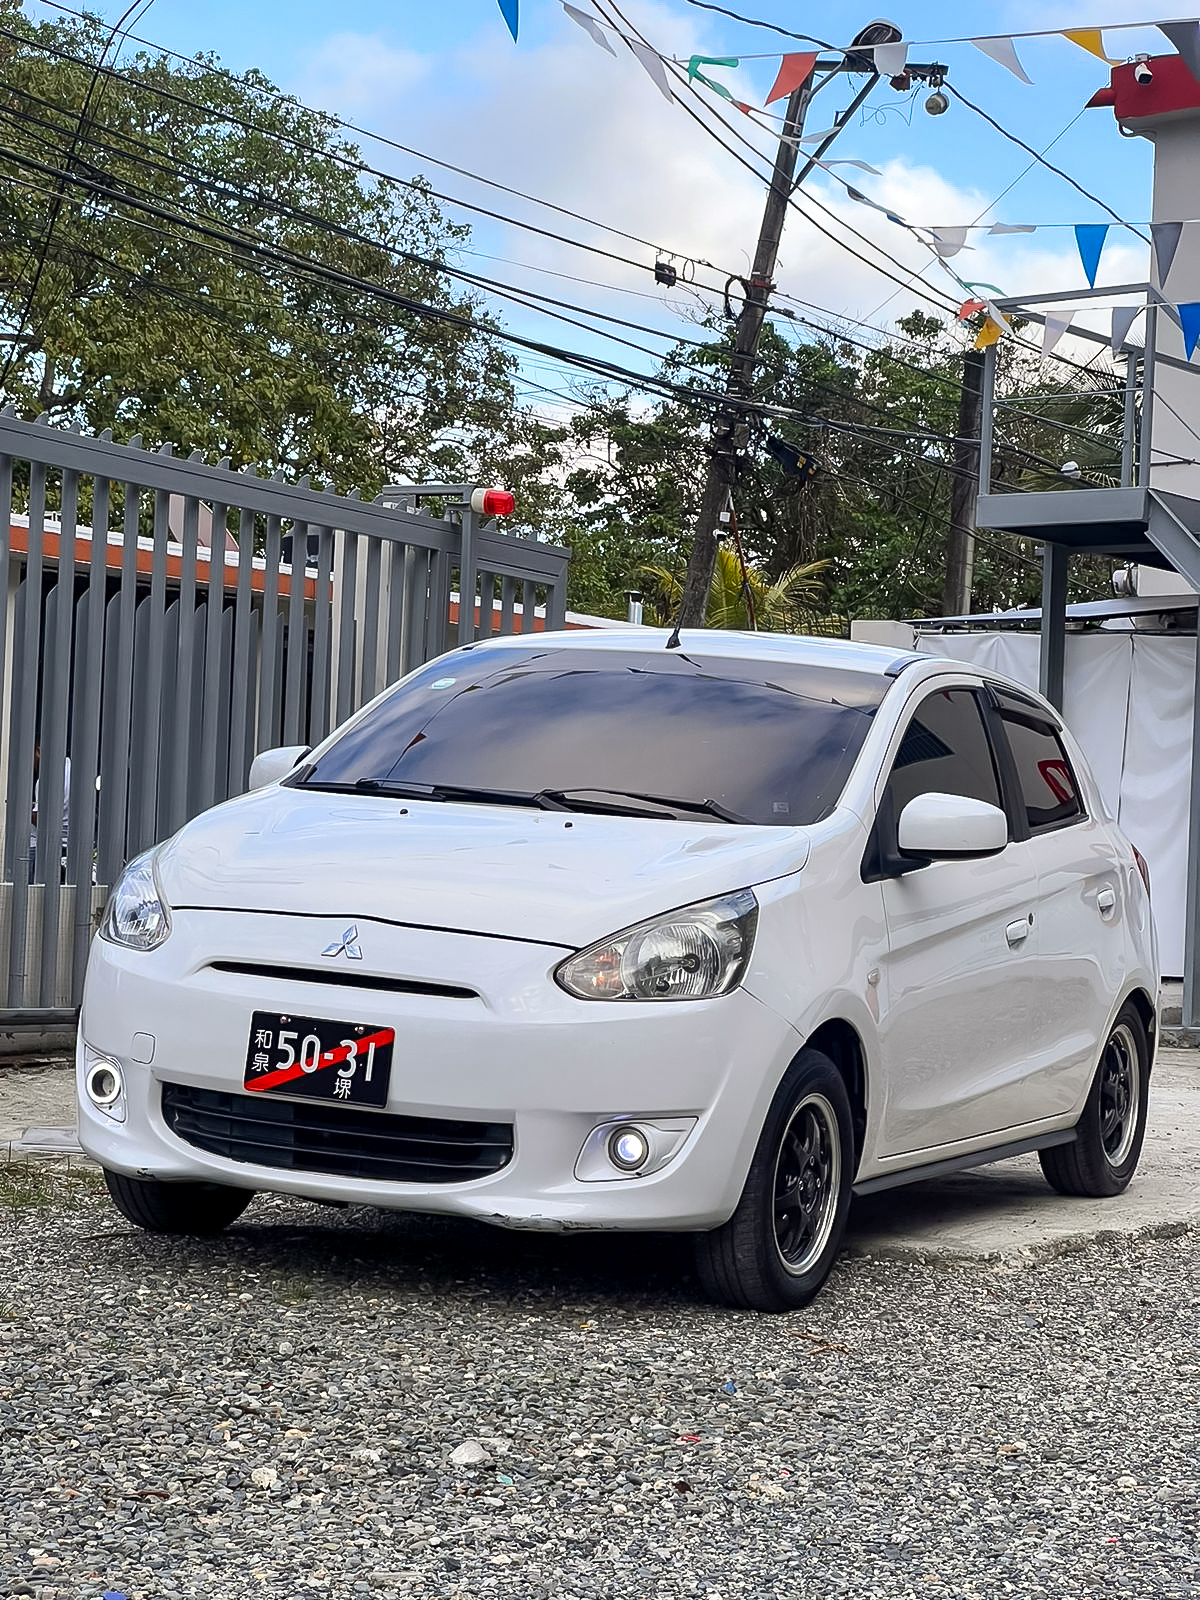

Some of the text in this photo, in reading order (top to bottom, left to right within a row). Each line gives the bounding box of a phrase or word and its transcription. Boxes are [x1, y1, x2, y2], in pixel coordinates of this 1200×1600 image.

[251, 1029, 273, 1072] 和泉
[275, 1030, 376, 1082] 50-31
[333, 1077, 352, 1099] 堺
